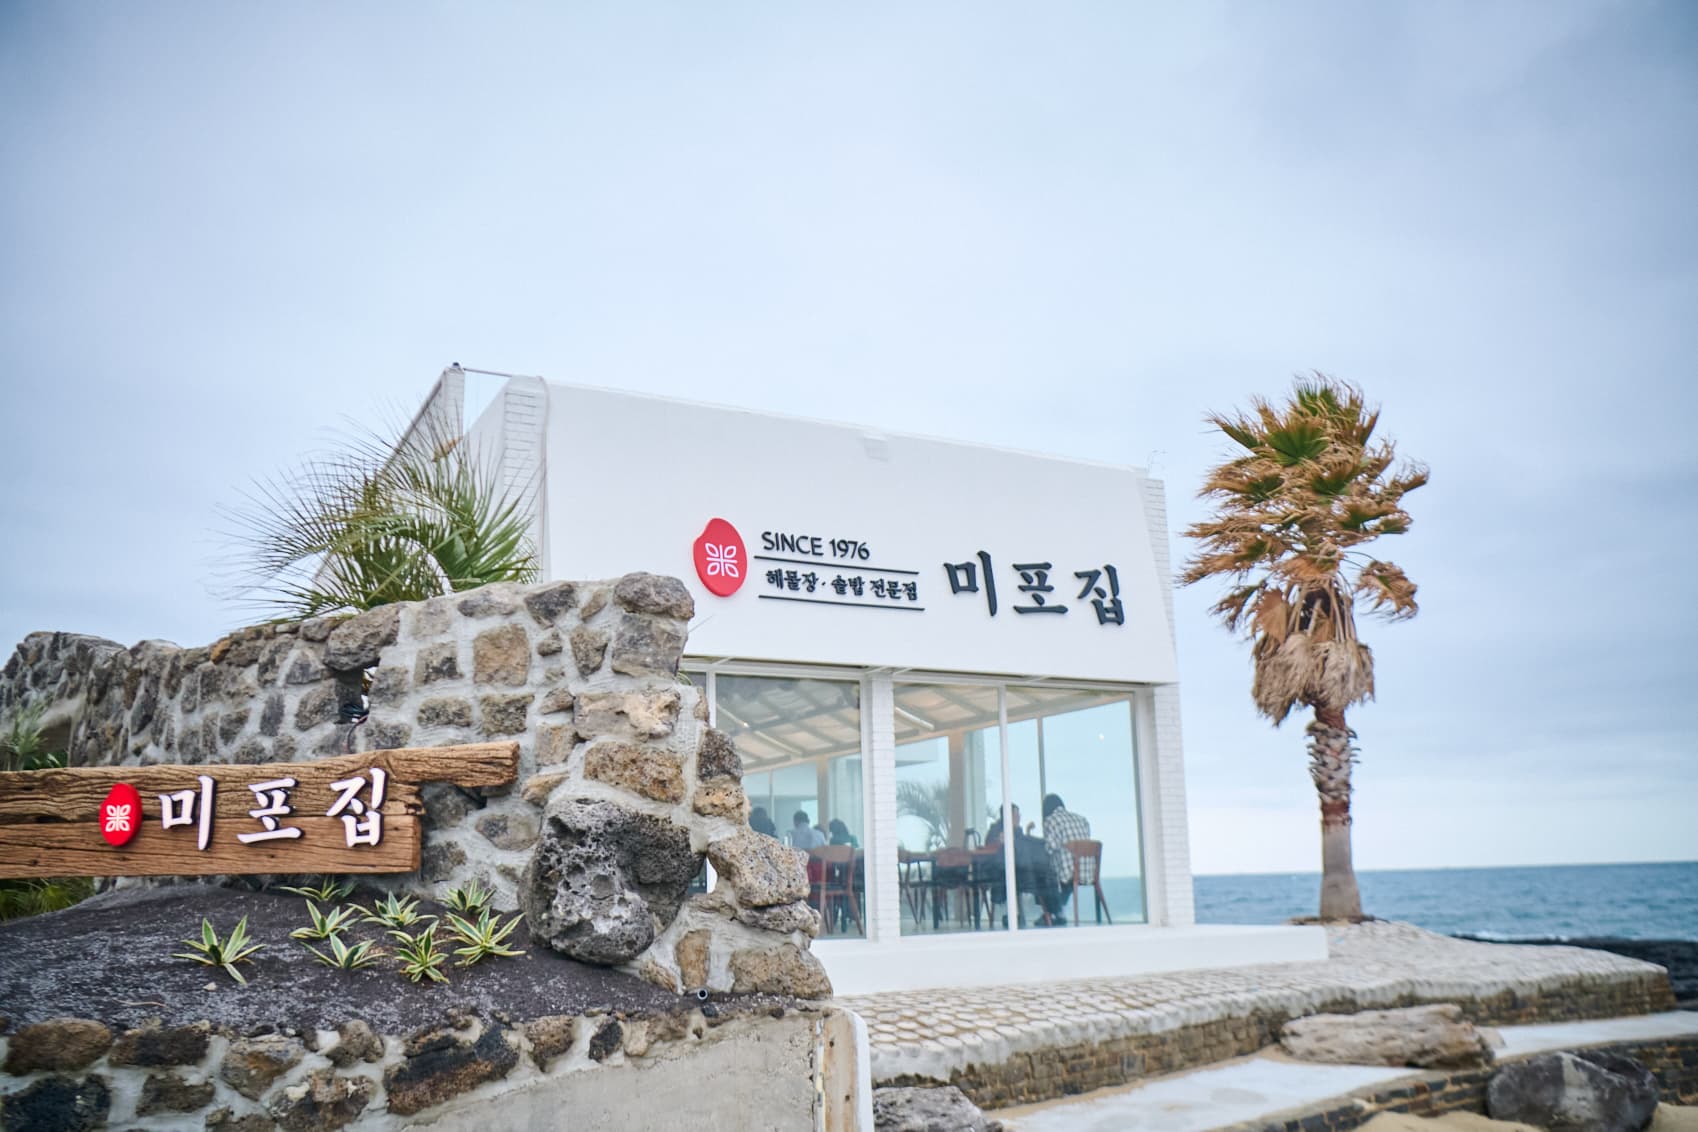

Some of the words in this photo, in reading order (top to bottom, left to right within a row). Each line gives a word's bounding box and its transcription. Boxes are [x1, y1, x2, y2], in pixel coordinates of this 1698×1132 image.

[761, 531, 824, 557] SINCE
[829, 538, 870, 560] 1976
[869, 577, 918, 601] 전문점
[943, 550, 1125, 626] 미포집
[158, 767, 386, 850] 미포집
